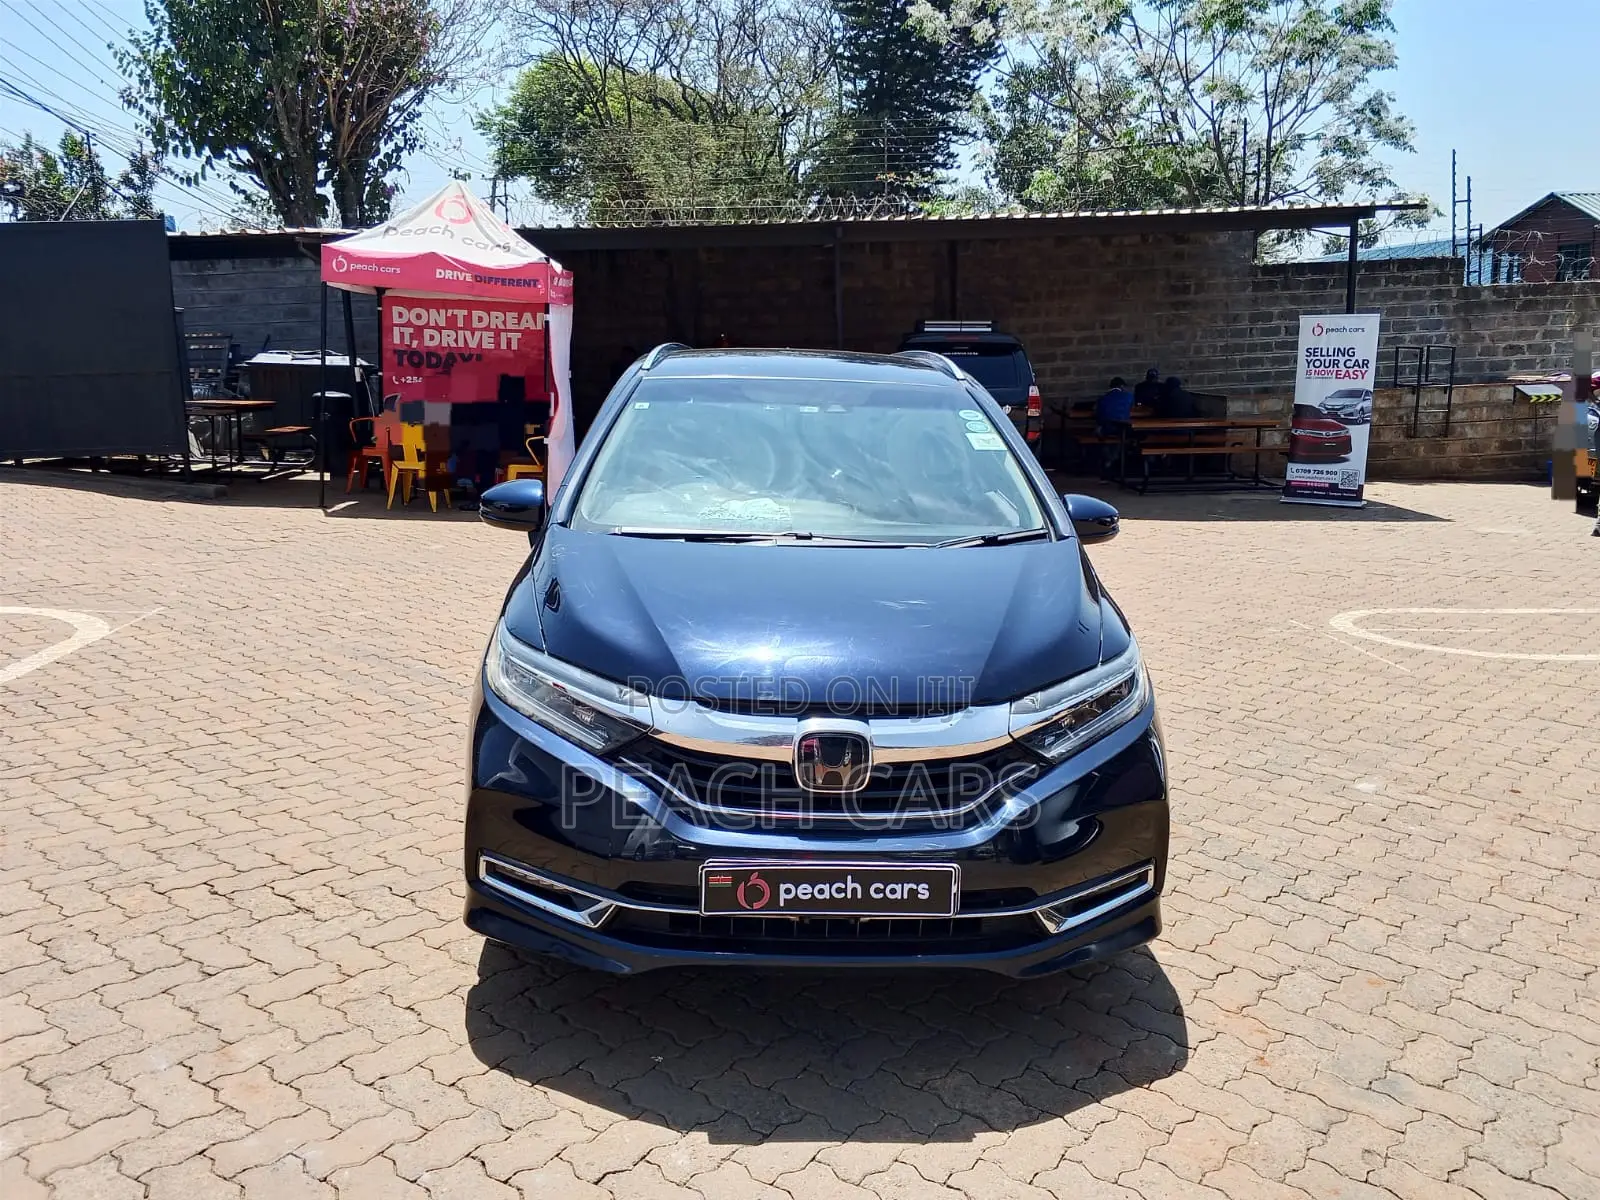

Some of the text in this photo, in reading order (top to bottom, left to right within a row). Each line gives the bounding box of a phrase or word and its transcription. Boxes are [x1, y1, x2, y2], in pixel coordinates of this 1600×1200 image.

[383, 225, 454, 239] peach
[350, 263, 401, 274] peach cars
[435, 269, 473, 282] DRIVE
[1326, 326, 1348, 335] peach
[393, 327, 522, 350] IT, DRIVE IT
[1305, 347, 1356, 358] SELLING
[1305, 358, 1370, 369] YOUR CAR
[1335, 369, 1368, 380] EASY
[779, 875, 930, 907] peach cars
